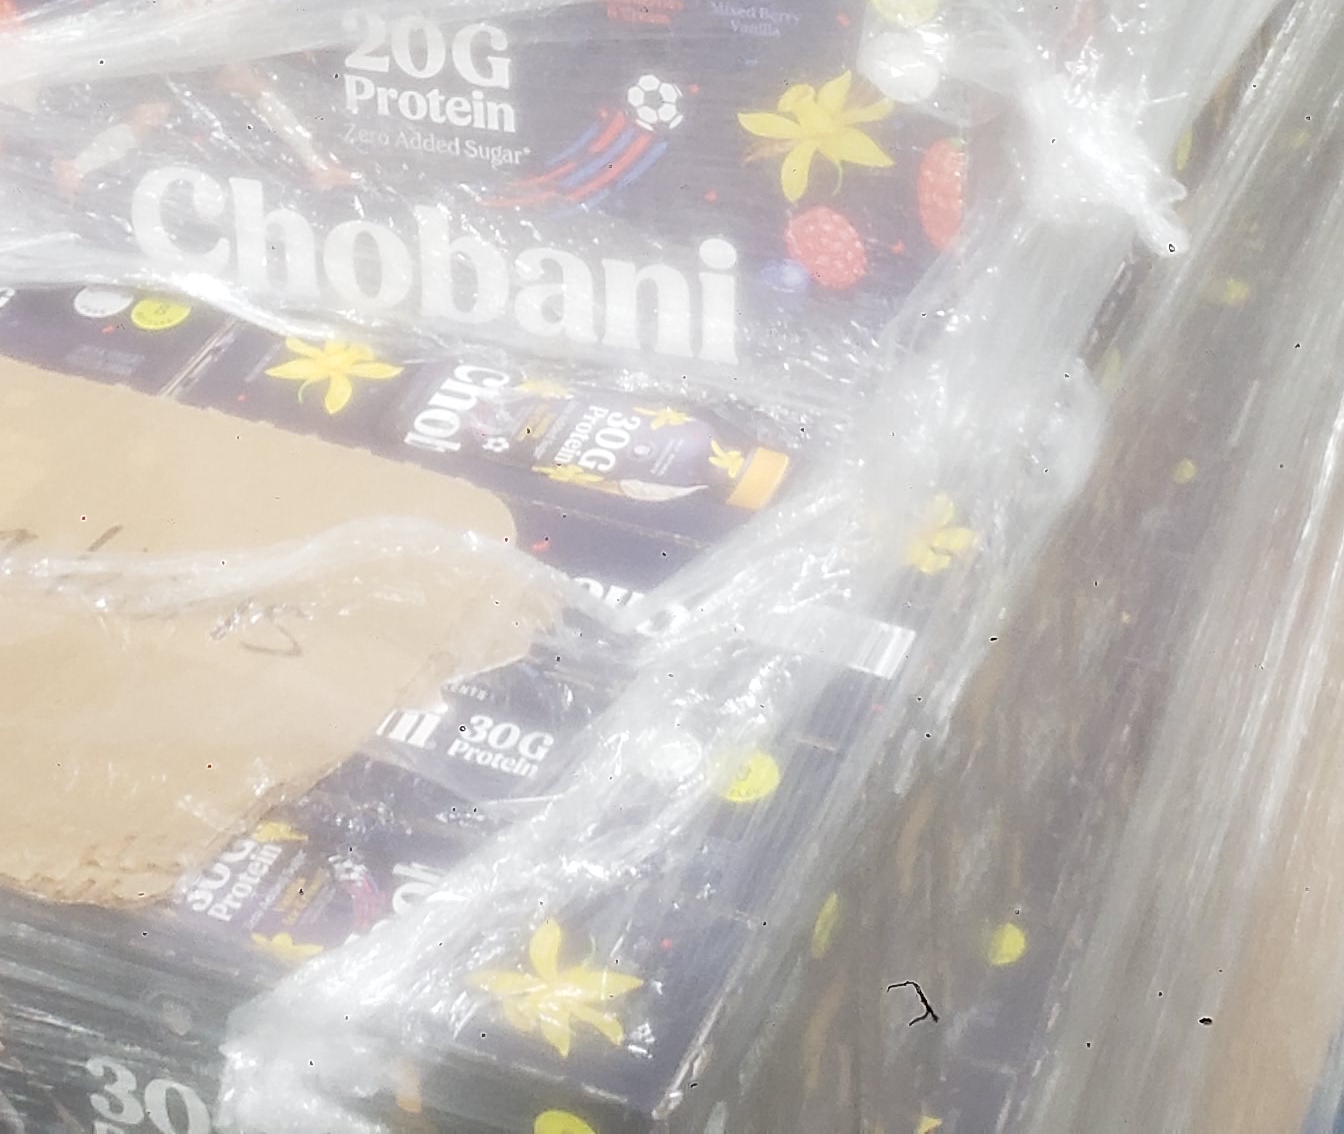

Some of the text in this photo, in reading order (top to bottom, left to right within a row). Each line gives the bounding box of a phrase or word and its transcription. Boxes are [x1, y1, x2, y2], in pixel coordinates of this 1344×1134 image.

[343, 9, 515, 90] 20G
[344, 73, 517, 134] Protein
[343, 121, 391, 149] Zero
[394, 127, 463, 157] Added
[131, 166, 739, 365] Chobani
[553, 403, 612, 468] Protein
[576, 410, 642, 474] 30G
[446, 739, 540, 779] Protein
[459, 714, 556, 762] 30G
[207, 842, 283, 923] Protein
